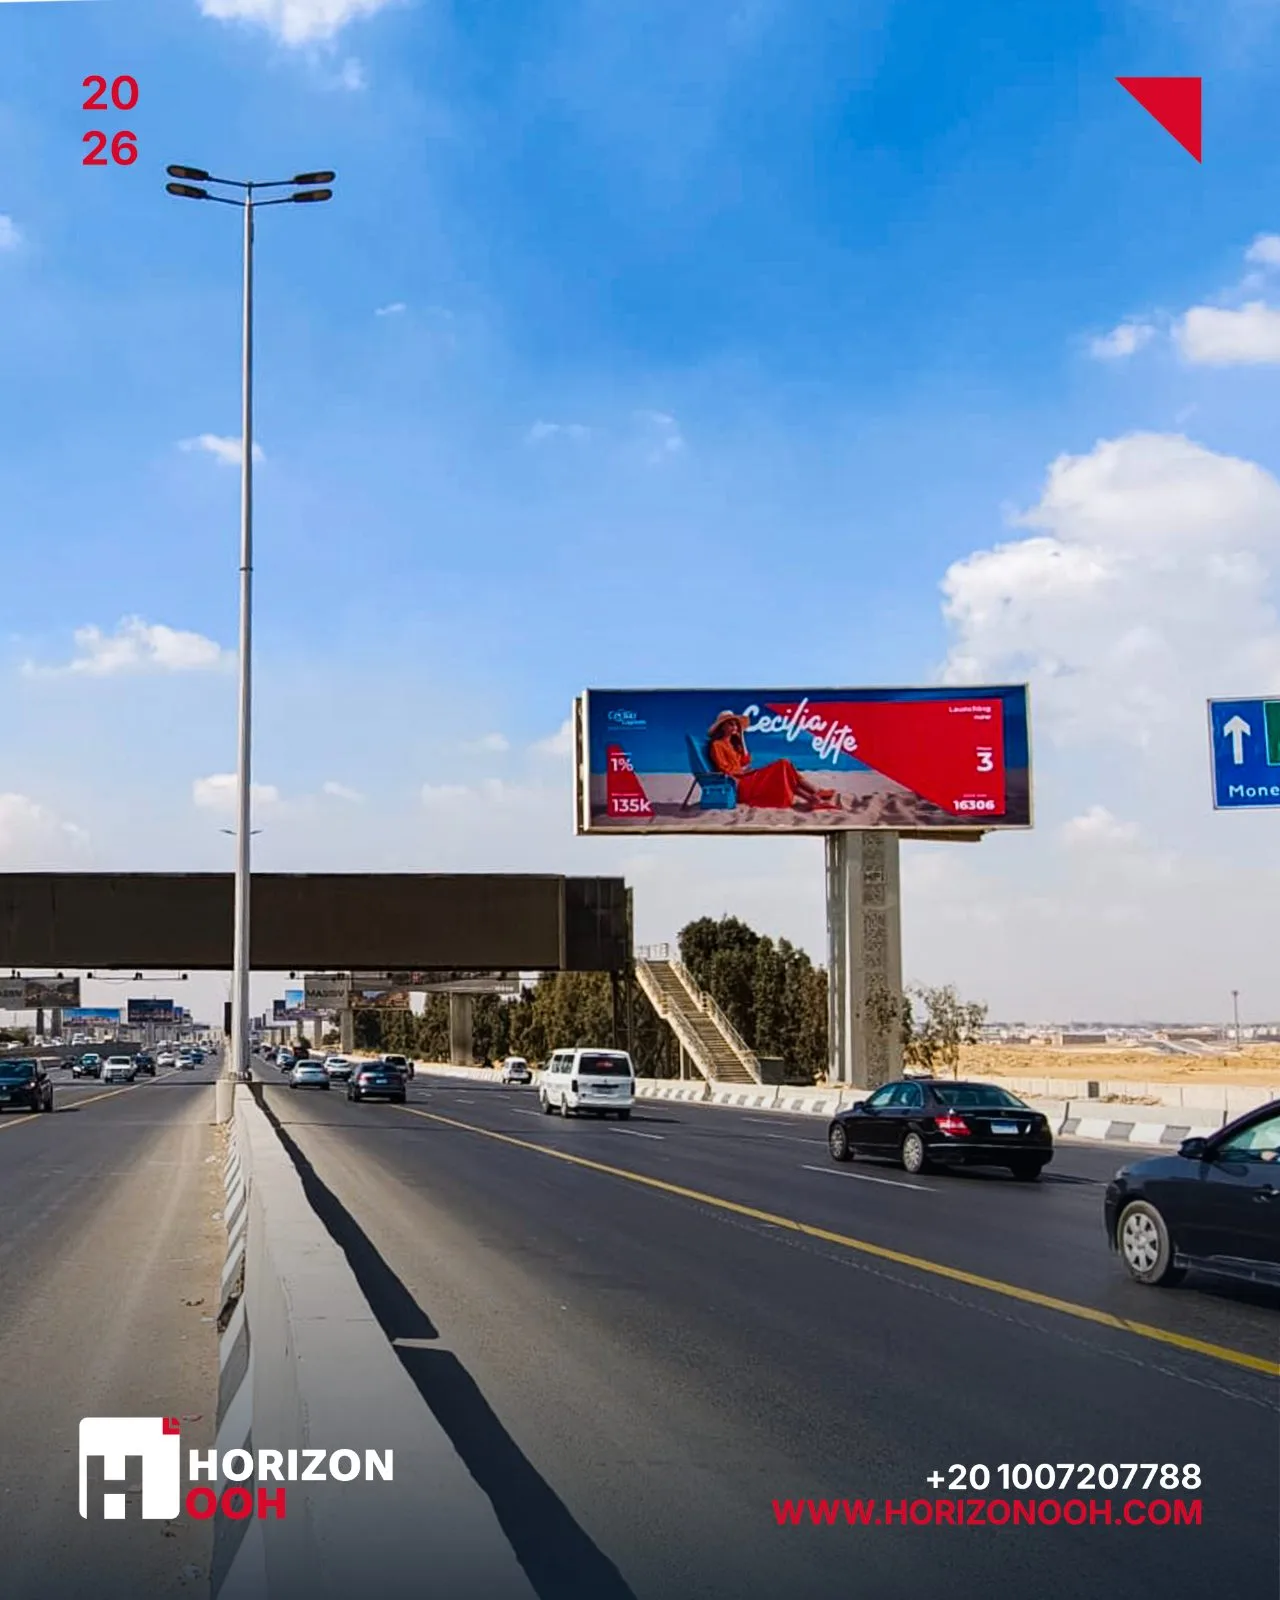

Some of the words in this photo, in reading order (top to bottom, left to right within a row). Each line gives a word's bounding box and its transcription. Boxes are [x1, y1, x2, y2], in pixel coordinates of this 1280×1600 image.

[742, 697, 827, 742] Cecilia
[610, 757, 634, 772] 1%
[976, 751, 994, 772] 3
[611, 798, 652, 812] 135k
[952, 799, 996, 811] 16306
